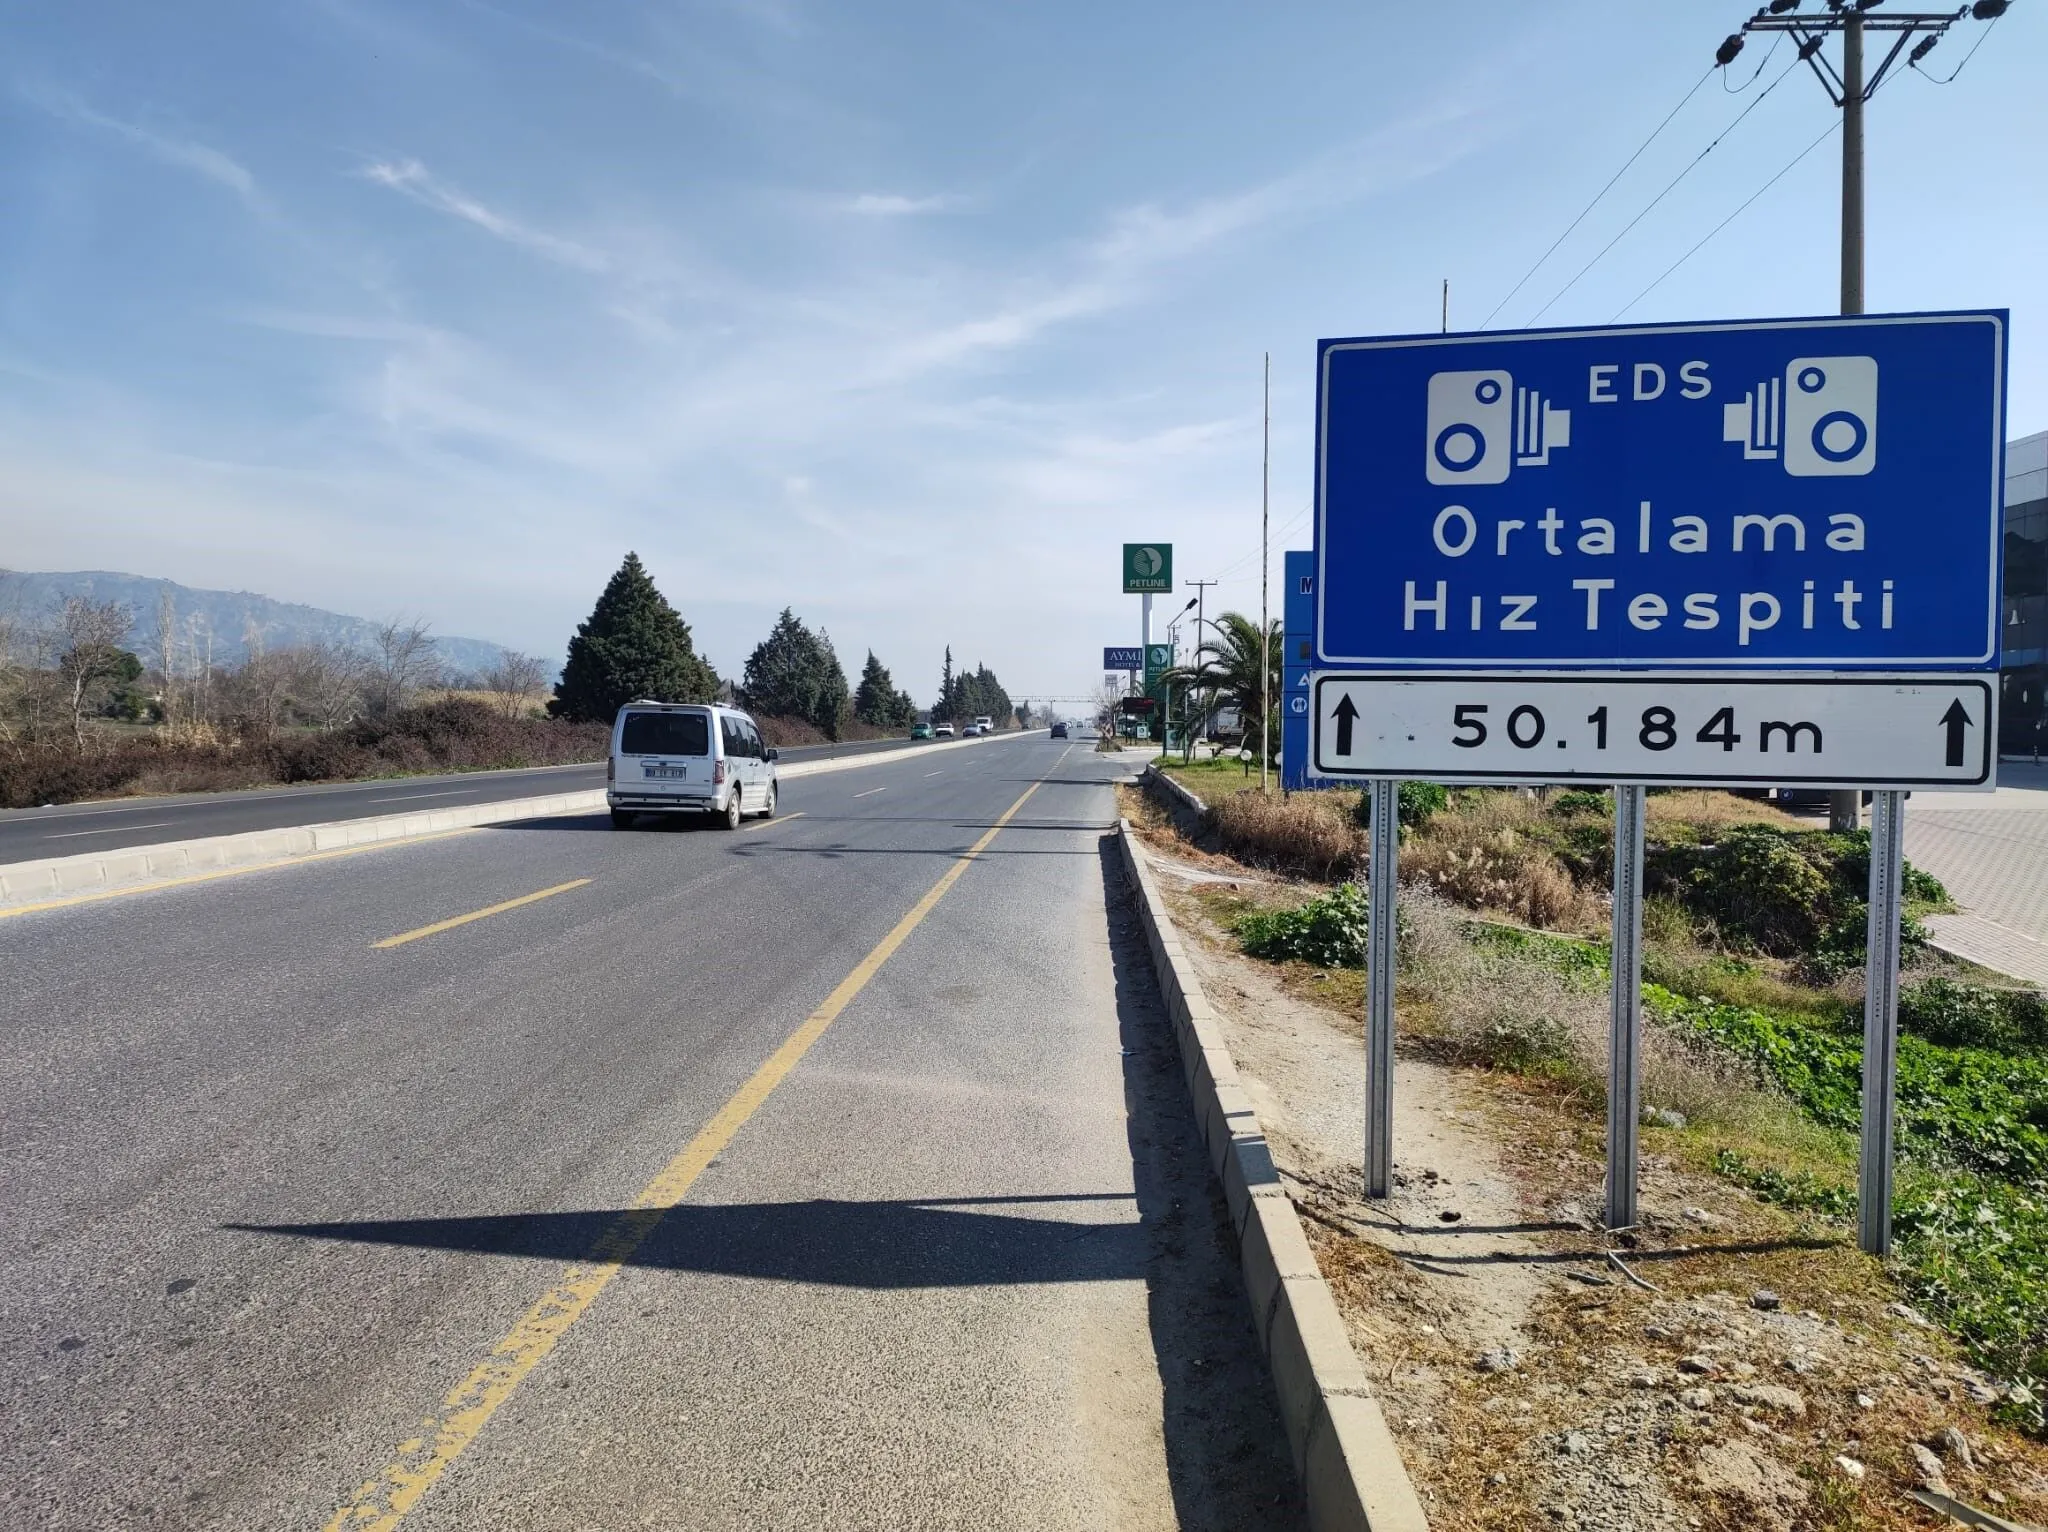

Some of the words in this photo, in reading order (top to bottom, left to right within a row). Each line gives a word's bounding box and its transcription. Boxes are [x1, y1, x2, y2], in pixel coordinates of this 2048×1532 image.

[1588, 360, 1712, 403] EDS
[1433, 501, 1866, 557] Ortalama
[1129, 578, 1166, 588] PETLINE
[1404, 580, 1538, 631] Hız
[1572, 579, 1894, 646] Tespiti
